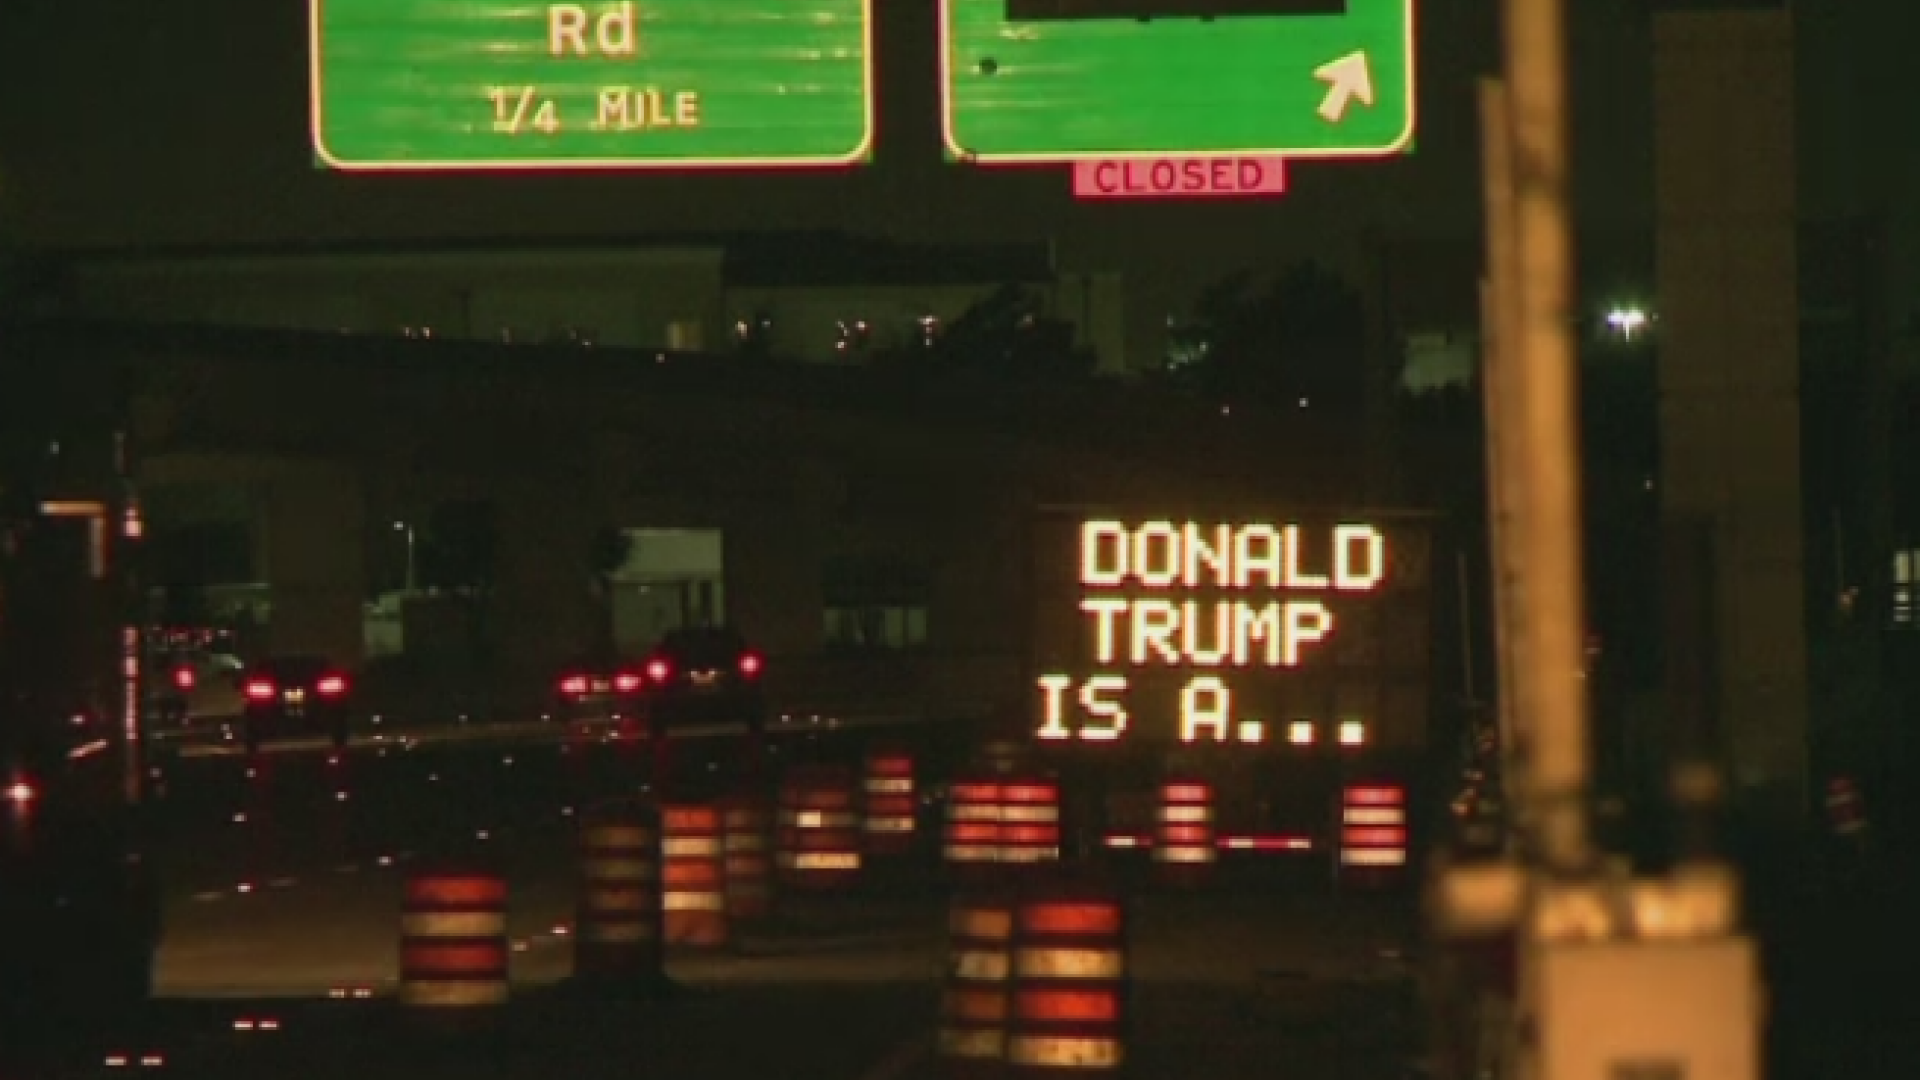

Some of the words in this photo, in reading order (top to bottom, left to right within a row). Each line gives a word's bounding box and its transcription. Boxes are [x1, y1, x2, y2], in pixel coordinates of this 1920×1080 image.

[549, 1, 637, 56] Rd
[598, 87, 700, 130] MILE
[1094, 160, 1264, 193] CLOSED
[1080, 520, 1384, 589] DONALD
[1080, 598, 1333, 666] TRUMP
[1036, 674, 1129, 740] IS
